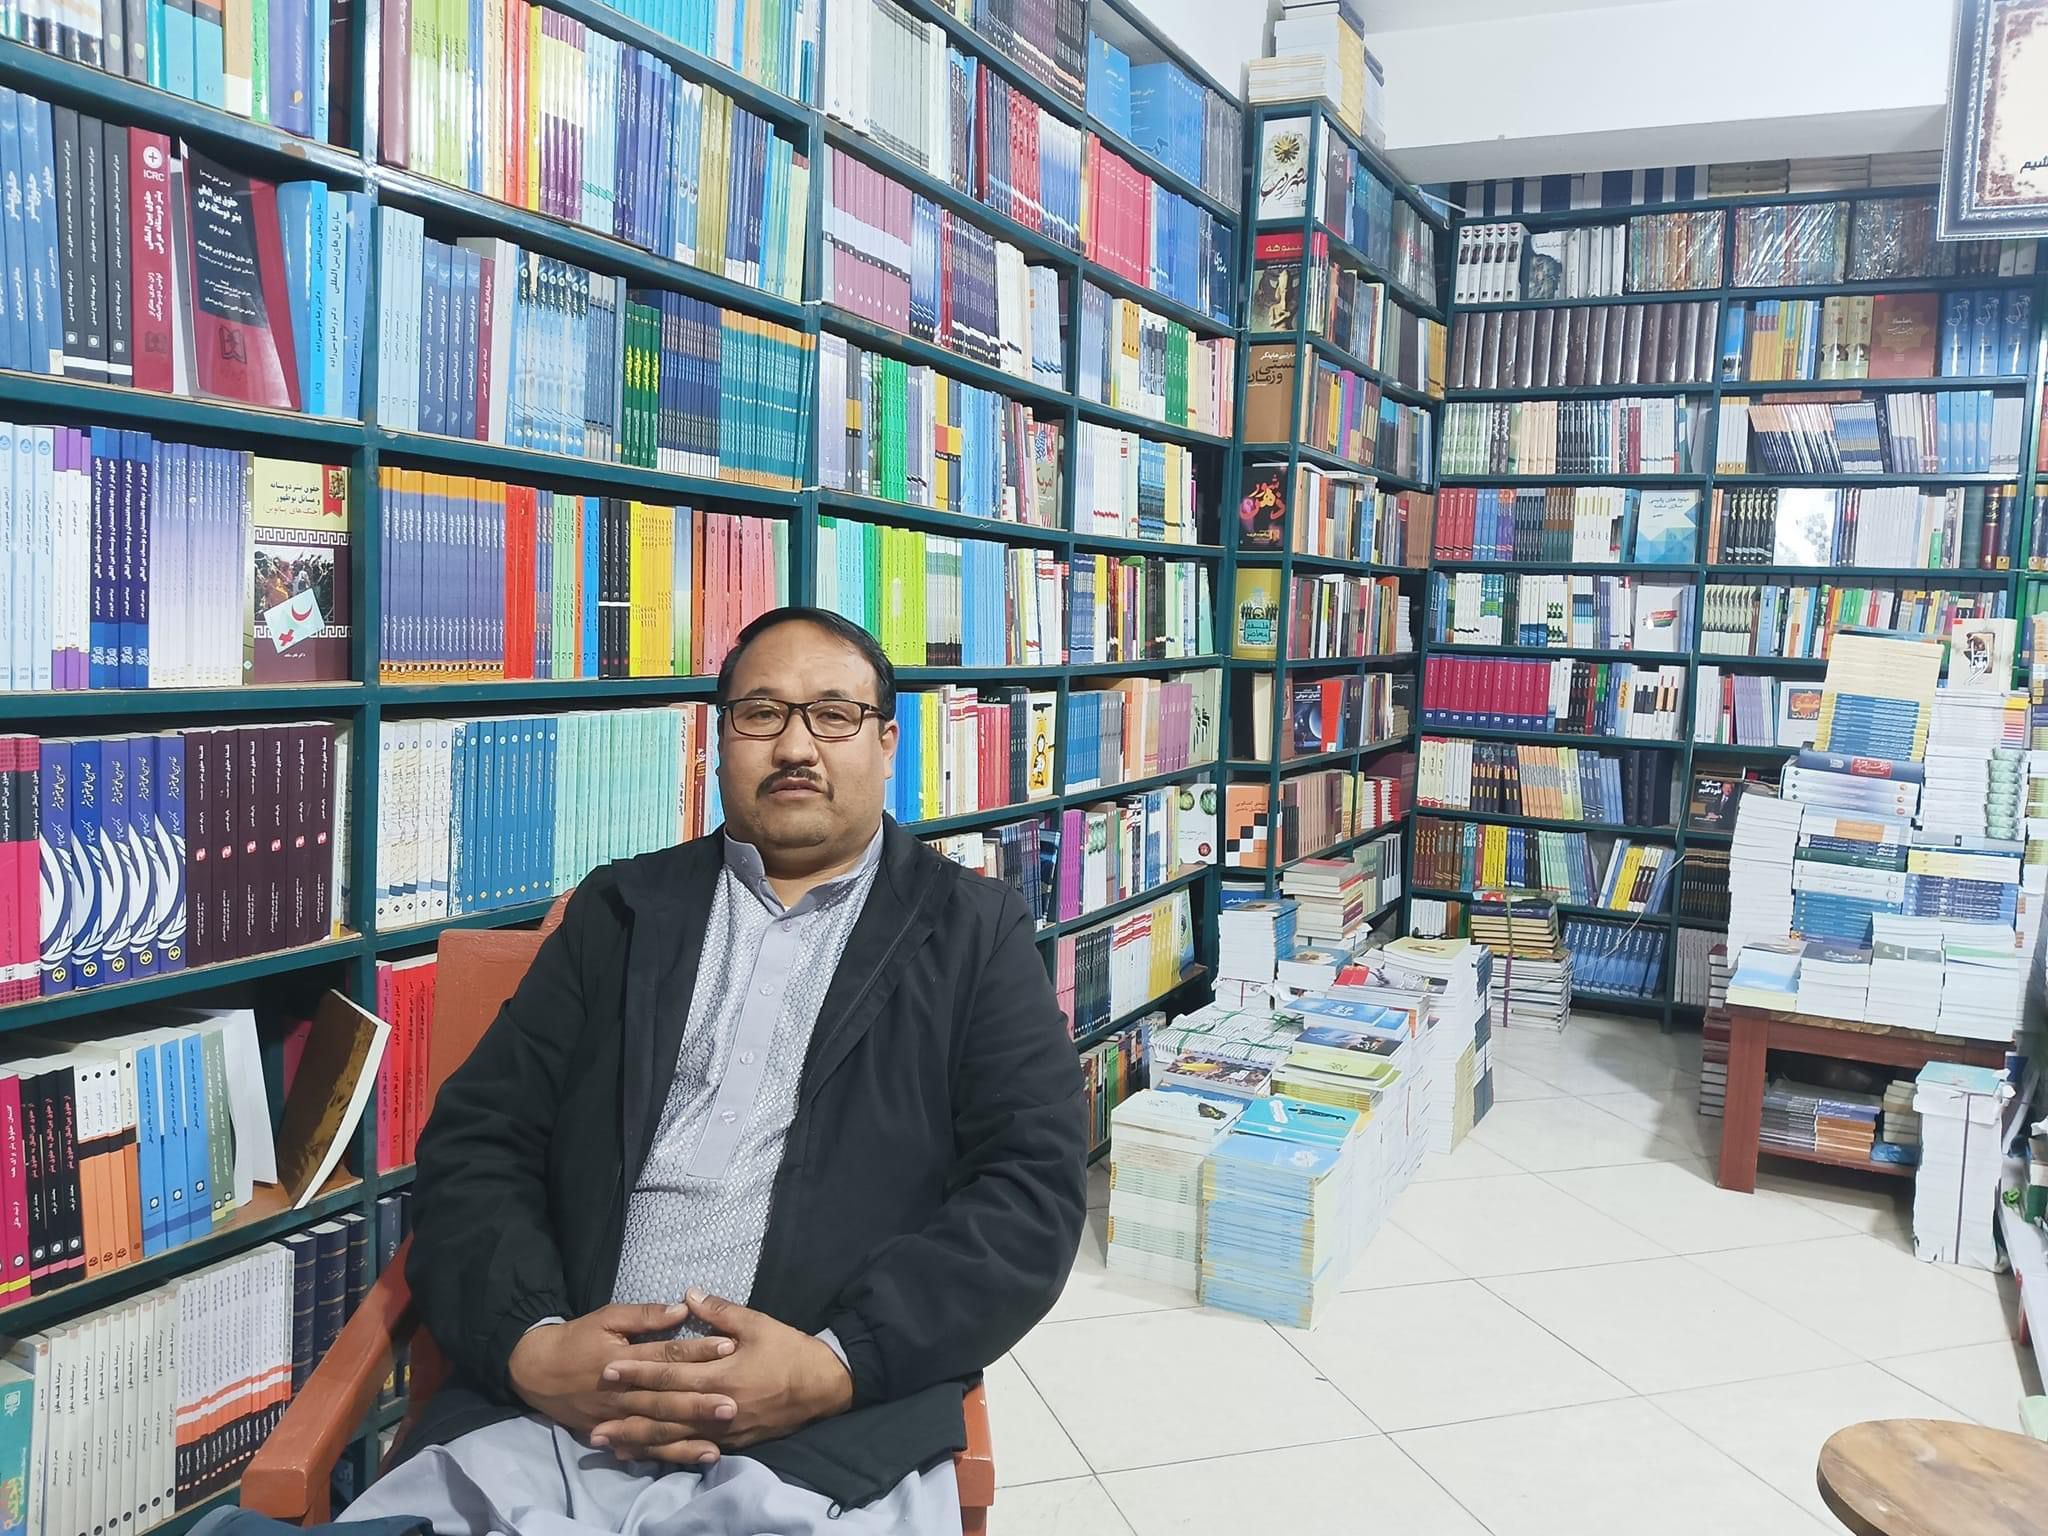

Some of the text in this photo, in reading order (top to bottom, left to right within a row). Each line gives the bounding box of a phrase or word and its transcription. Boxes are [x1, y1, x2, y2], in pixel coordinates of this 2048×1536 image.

[143, 170, 165, 182] ICRC
[144, 191, 154, 249] حقوق بین المللی
[154, 191, 164, 254] بشر دوستانه عرفی
[1259, 359, 1296, 374] ستی
[293, 484, 302, 492] بشر
